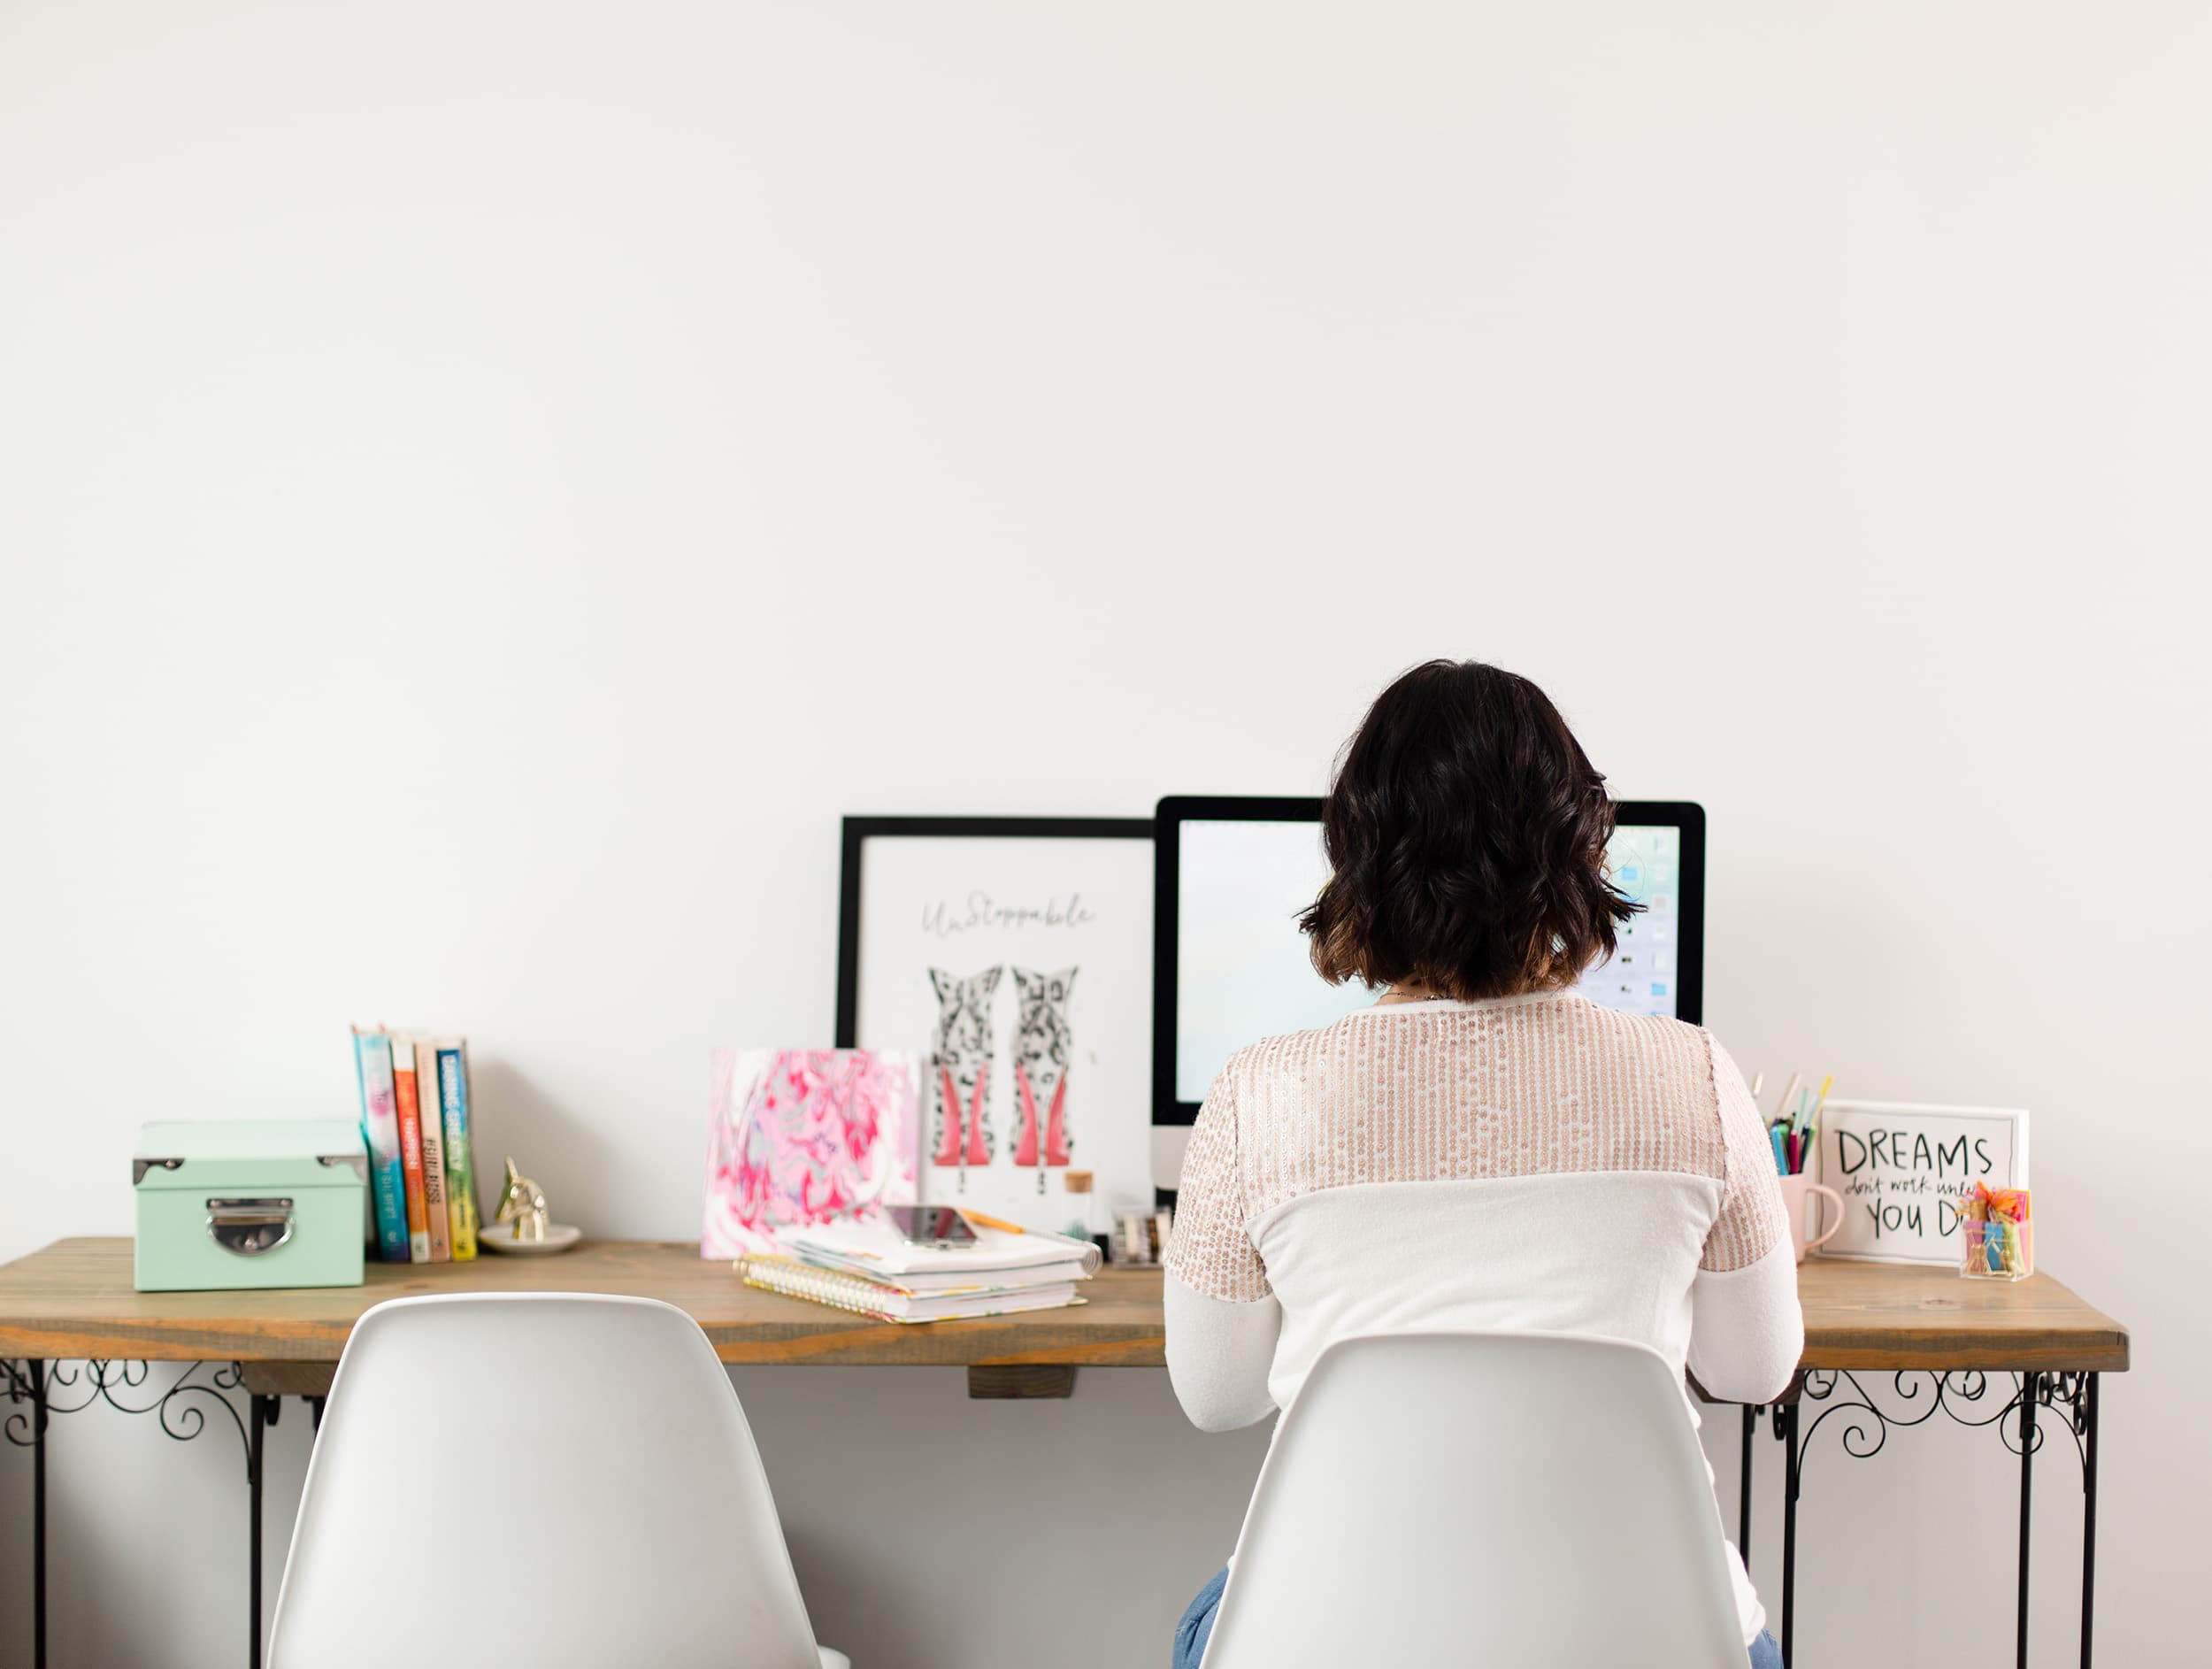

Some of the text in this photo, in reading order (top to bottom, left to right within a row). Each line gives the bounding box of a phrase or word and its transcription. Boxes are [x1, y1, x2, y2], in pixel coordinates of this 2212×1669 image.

[442, 1053, 461, 1109] DARING
[445, 1110, 465, 1173] GREATLY
[1834, 1129, 1992, 1179] DREAMS
[1846, 1175, 1882, 1196] don't
[1891, 1176, 1932, 1195] work
[1866, 1197, 1964, 1240] YOU D
